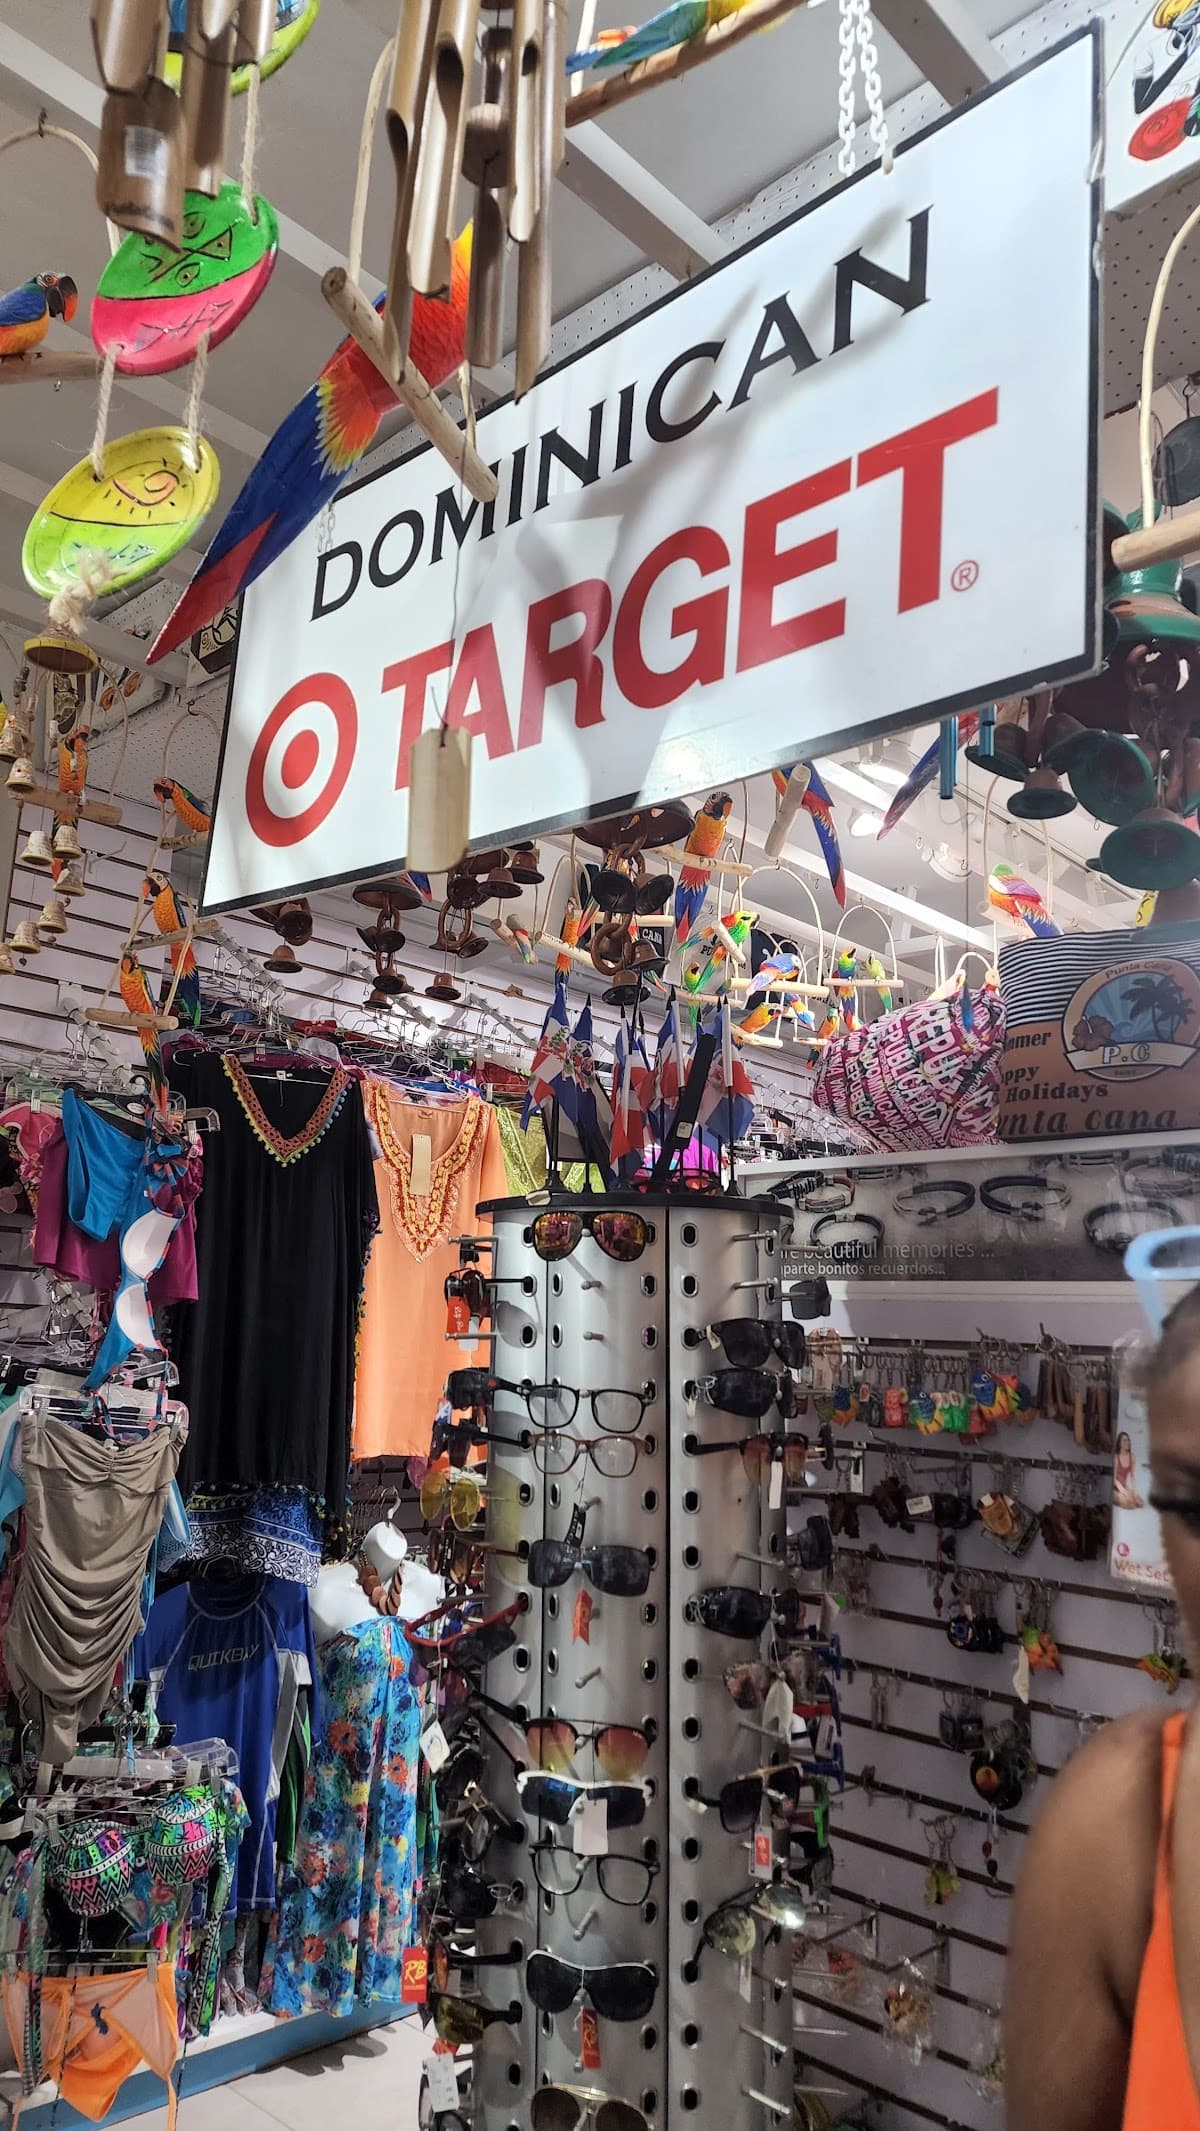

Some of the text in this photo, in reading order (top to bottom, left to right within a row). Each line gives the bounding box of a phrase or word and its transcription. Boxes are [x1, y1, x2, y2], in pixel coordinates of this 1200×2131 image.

[311, 205, 934, 621] DOMINICAN
[381, 386, 1000, 791] TARGET
[1105, 964, 1140, 979] Punta
[1102, 1043, 1150, 1065] P.C
[1006, 1082, 1109, 1104] Holidays
[883, 1240, 975, 1258] memories
[818, 1261, 865, 1275] bonitos
[405, 1959, 428, 1984] RB
